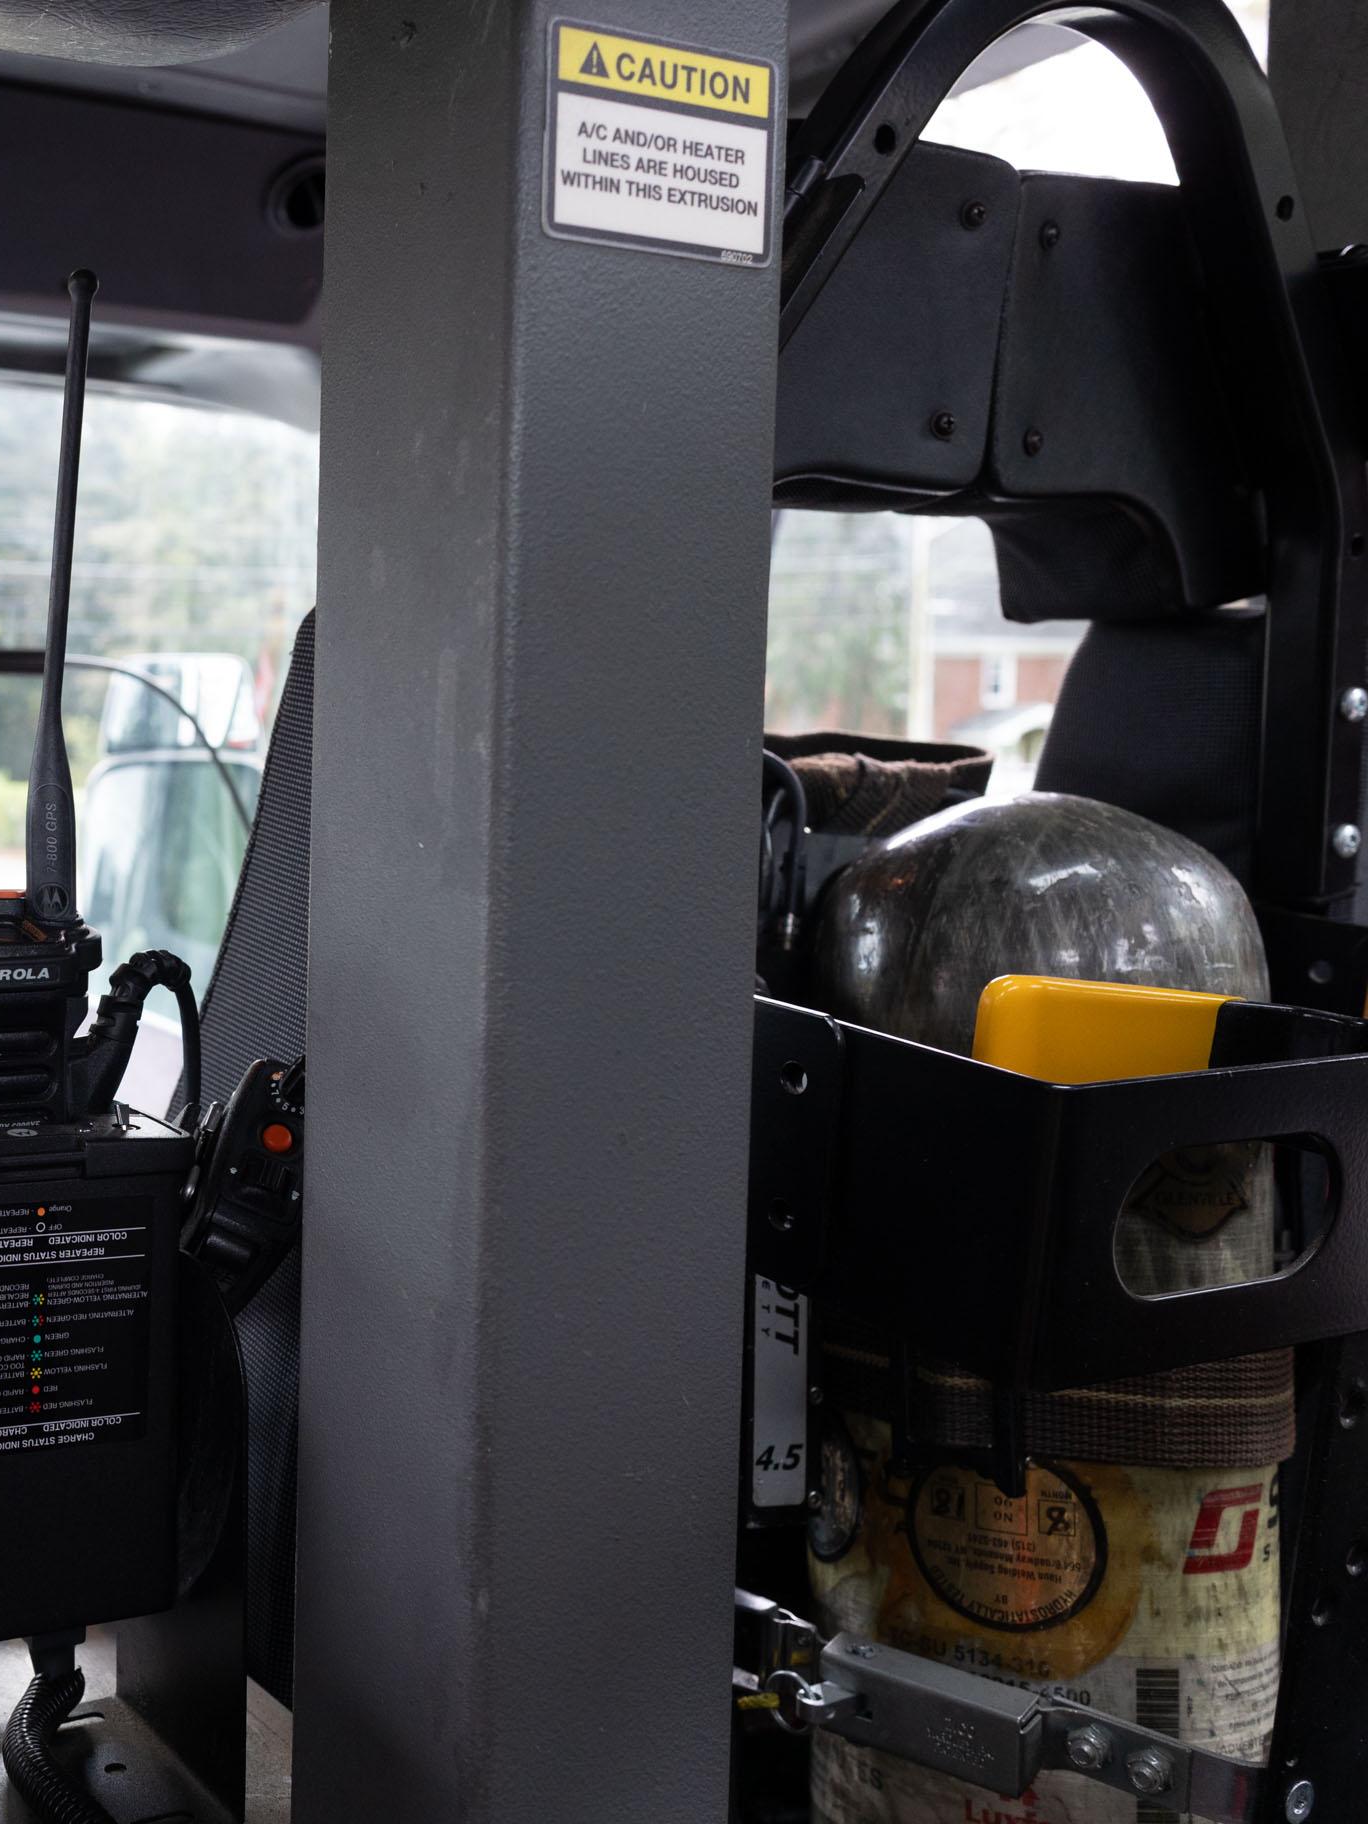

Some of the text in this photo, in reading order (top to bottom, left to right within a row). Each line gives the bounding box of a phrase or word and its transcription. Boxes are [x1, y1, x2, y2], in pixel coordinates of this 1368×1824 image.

[615, 53, 751, 104] CAUTION
[577, 121, 745, 165] A/C AND/OR HEATER
[582, 148, 740, 188] LINES ARE HOUSED
[561, 170, 758, 217] WITHIN THIS EXTRUSION
[45, 803, 57, 832] GPS
[49, 1234, 94, 1245] INDICATED
[97, 1232, 127, 1241] COLOR
[23, 1251, 56, 1261] STATUS
[59, 1247, 104, 1258] REPEATER
[47, 1294, 101, 1305] YELLOW-GREEN
[103, 1290, 148, 1301] ALTERNATING
[46, 1313, 87, 1323] RED-GREEN
[88, 1309, 134, 1319] ALTERNATING
[45, 1332, 70, 1340] GREEN
[44, 1349, 69, 1358] GREEN
[70, 1346, 104, 1355] FLASHING
[4, 1354, 25, 1362] RAPID
[10, 1362, 24, 1370] TOO
[44, 1366, 72, 1375] YELLOW
[74, 1362, 107, 1372] FLASHING
[3, 1388, 24, 1396] RAPID
[43, 1402, 57, 1410] RED
[59, 1398, 92, 1408] FLASHING
[43, 1420, 89, 1431] INDICATED
[91, 1416, 121, 1426] COLOR
[22, 1436, 55, 1448] STATUS
[58, 1432, 94, 1444] CHARGE
[755, 1444, 804, 1471] 4.5
